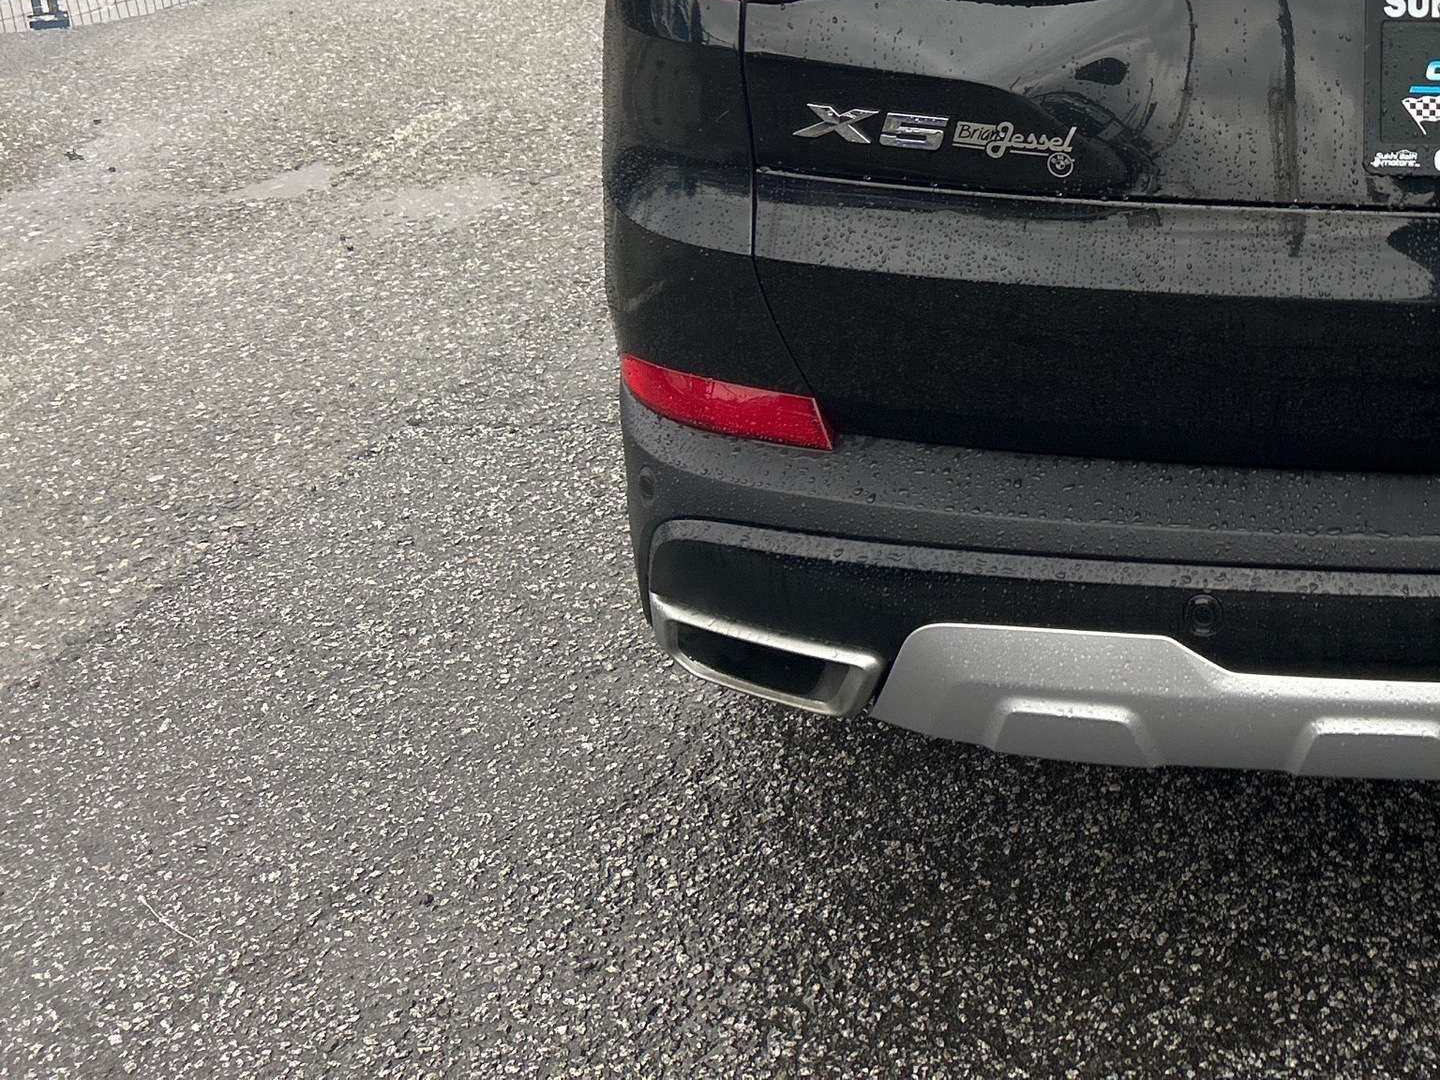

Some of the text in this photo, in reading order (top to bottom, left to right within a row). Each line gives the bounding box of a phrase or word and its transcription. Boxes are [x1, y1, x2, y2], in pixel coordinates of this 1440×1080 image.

[792, 103, 1078, 159] X5 Brian Jessel
